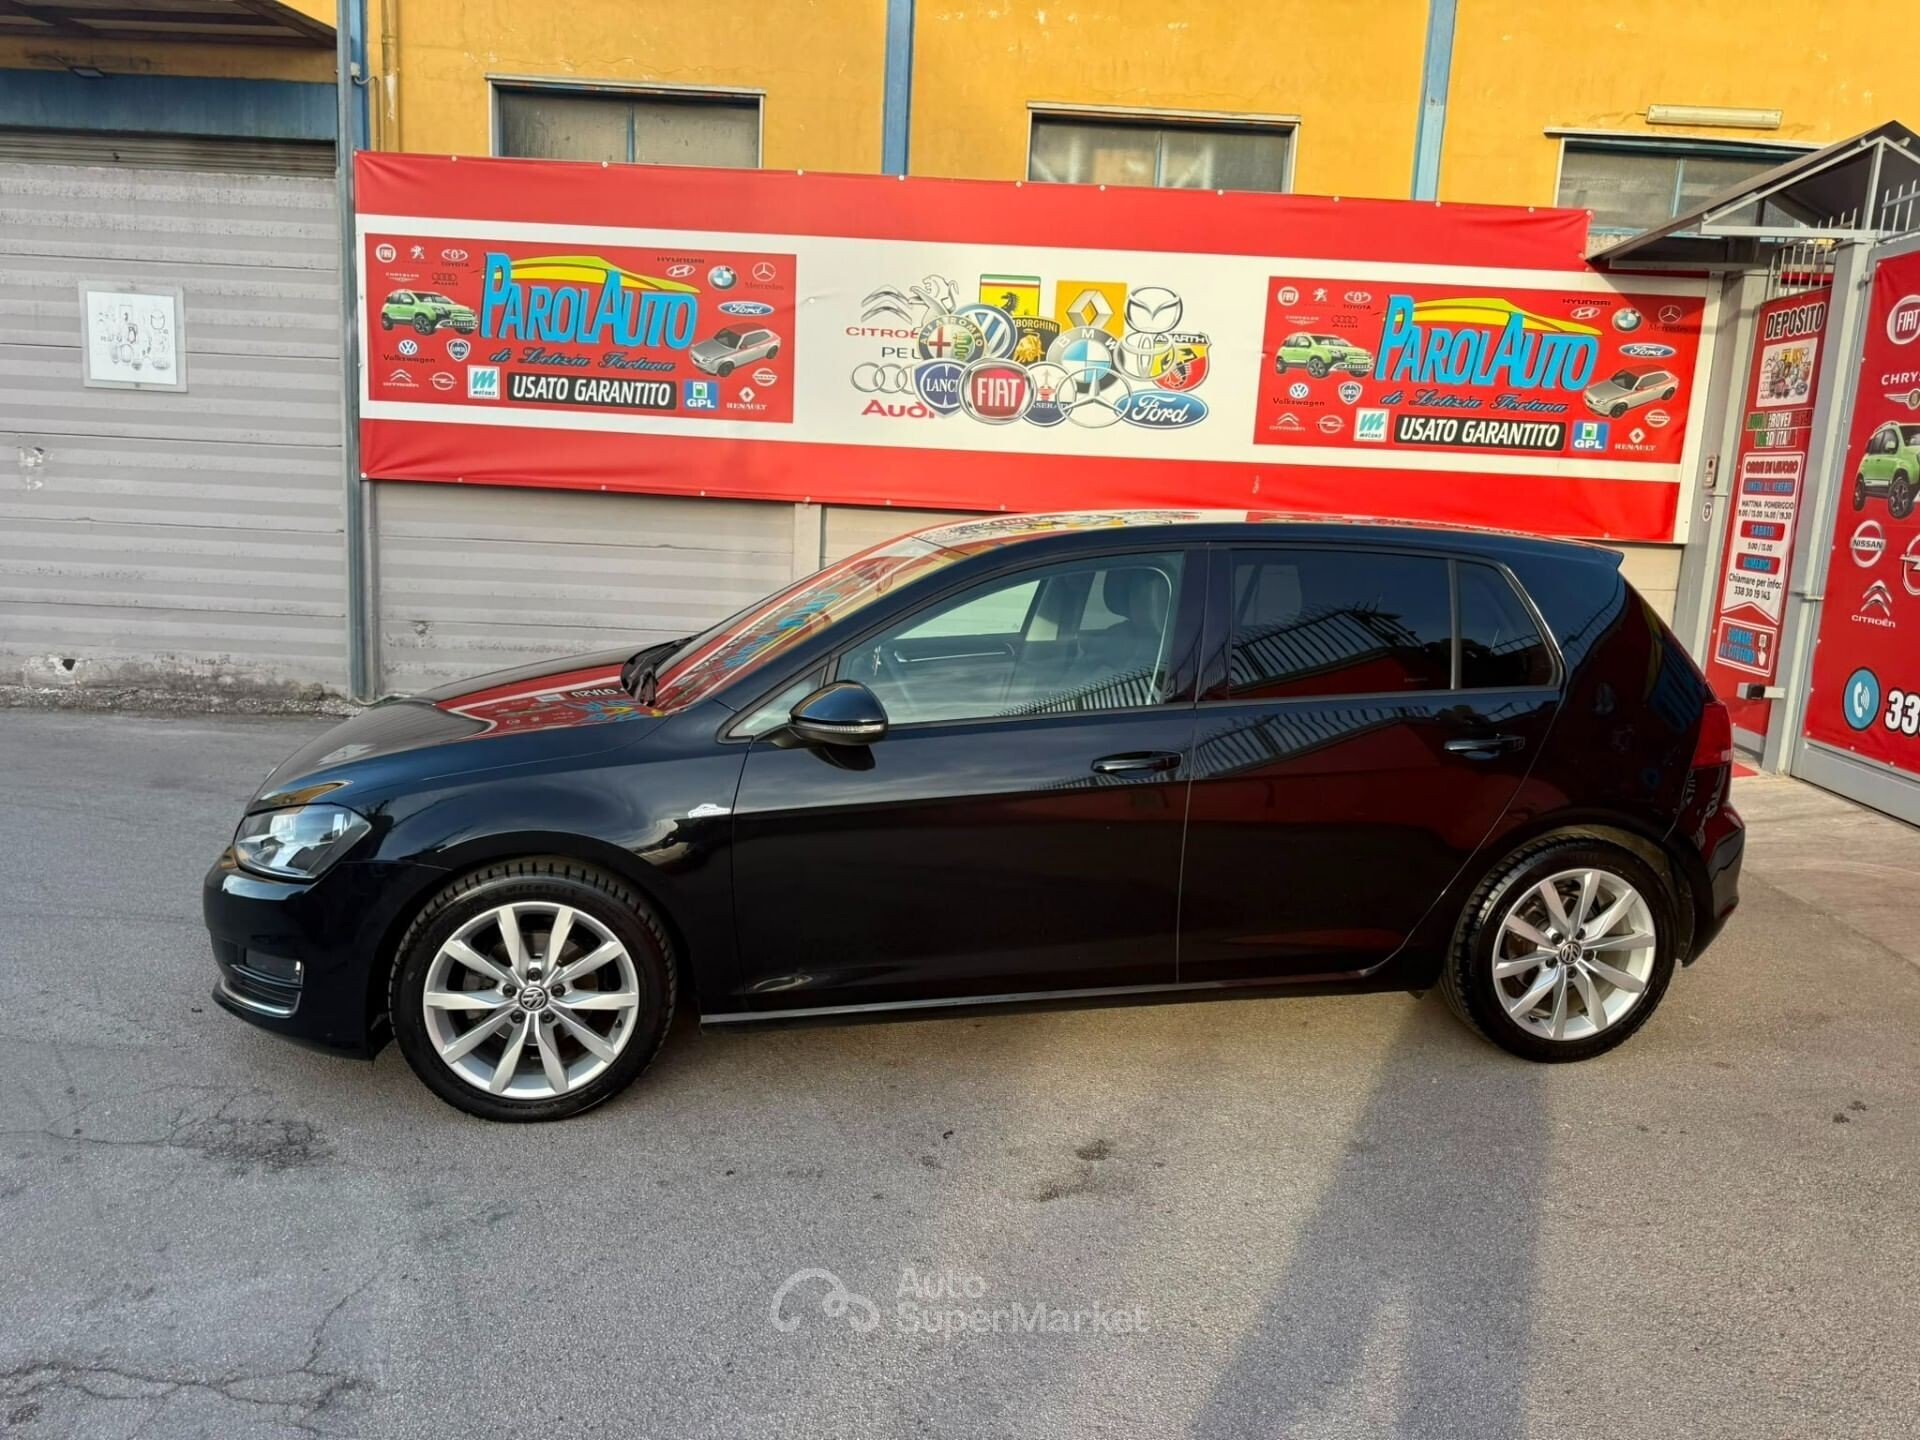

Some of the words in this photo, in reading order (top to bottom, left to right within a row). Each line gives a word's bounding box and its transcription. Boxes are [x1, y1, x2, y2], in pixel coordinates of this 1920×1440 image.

[728, 303, 763, 315] Ford
[1015, 318, 1059, 334] BORGHINI
[1765, 303, 1826, 339] DEPOSITO
[1896, 311, 1919, 333] FIAT
[951, 315, 984, 348] ROMEO
[1055, 328, 1120, 352] BMW
[1629, 344, 1665, 356] Ford
[383, 353, 436, 364] Volkswagen
[489, 347, 512, 363] di
[597, 351, 676, 371] Fortuna
[1881, 371, 1920, 386] CHRY
[513, 375, 569, 400] USATO
[574, 378, 671, 406] GARANTITO
[976, 377, 1021, 408] FIAT
[686, 398, 716, 409] GPL
[726, 402, 768, 411] RENAULT
[1131, 395, 1190, 423] Ford
[1272, 397, 1325, 407] Volkswagen
[1380, 390, 1404, 405] di
[1490, 393, 1569, 413] Fortuna
[1401, 417, 1458, 442] USATO
[1461, 420, 1560, 447] GARANTITO
[1573, 439, 1604, 450] GPL
[1614, 443, 1657, 452] RENAULT
[1742, 500, 1762, 508] MATTINA
[1852, 539, 1884, 550] NISSAN
[1728, 572, 1756, 586] Chiamare
[1756, 578, 1767, 589] per
[1766, 577, 1782, 590] info:
[1734, 585, 1745, 596] 338
[1745, 587, 1754, 598] 30
[1754, 589, 1760, 599] 19
[1884, 690, 1920, 736] 33
